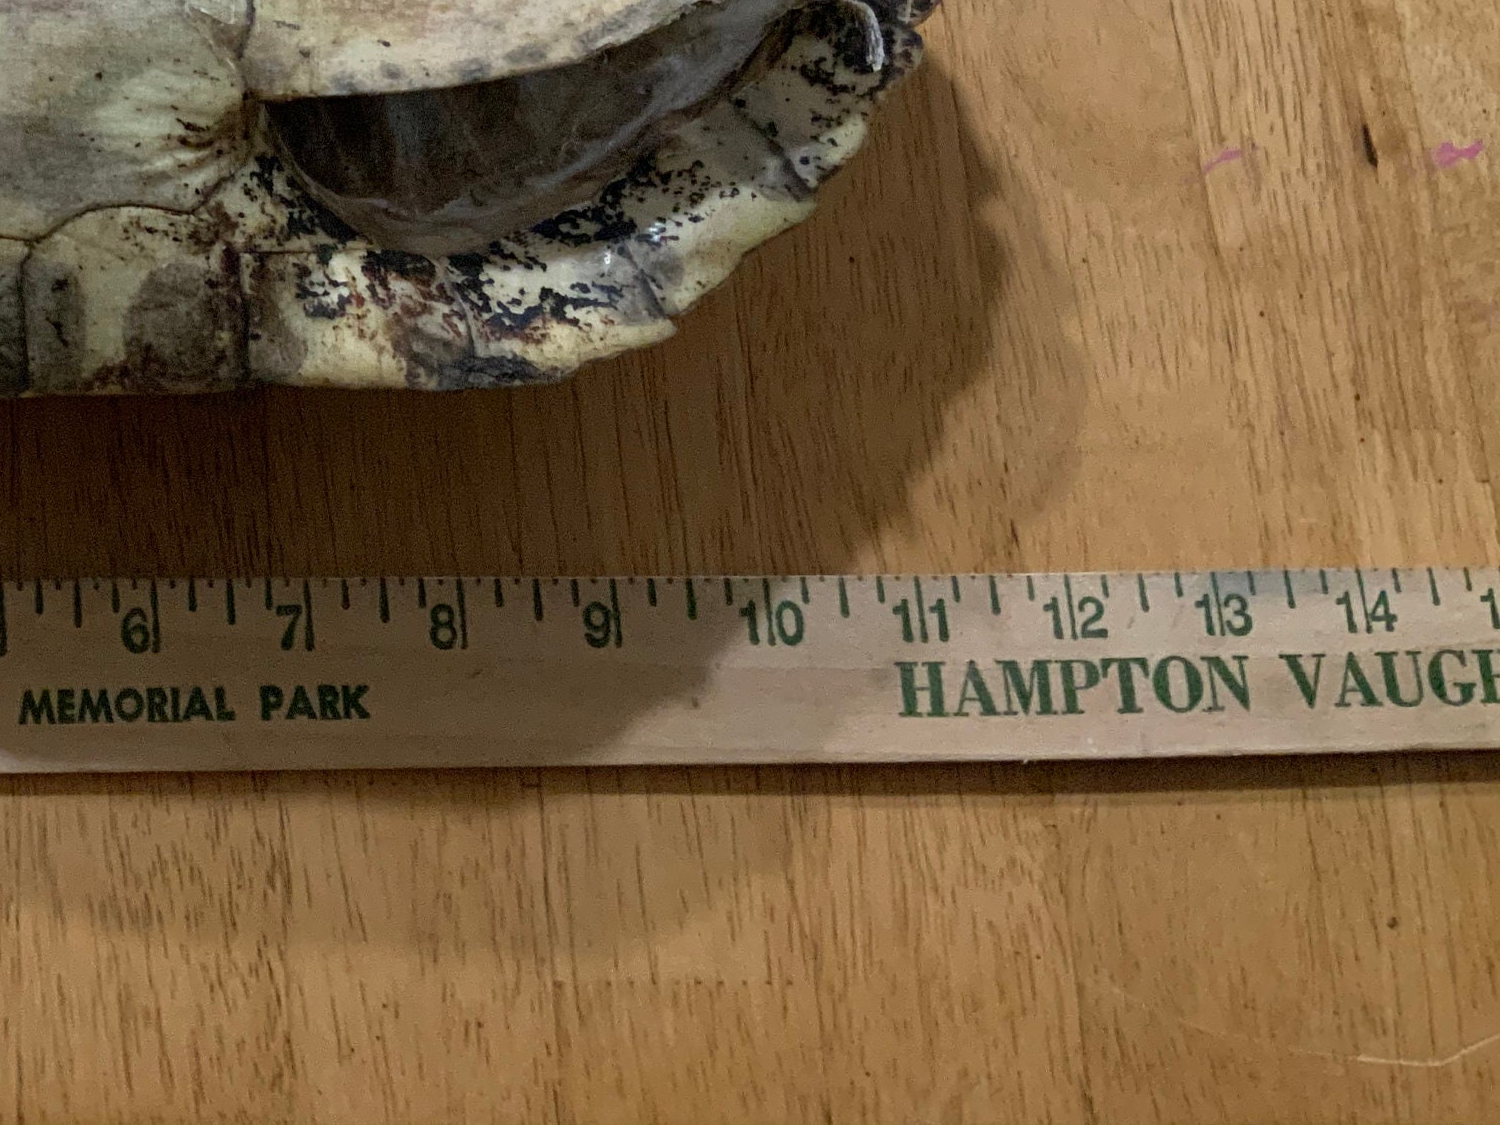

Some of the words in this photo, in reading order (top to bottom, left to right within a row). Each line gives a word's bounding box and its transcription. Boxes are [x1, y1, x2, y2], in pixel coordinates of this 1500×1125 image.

[121, 607, 150, 655] 6
[275, 604, 302, 652] 7
[429, 603, 458, 650] 8
[582, 601, 611, 648] 9
[739, 599, 804, 646] 10
[1043, 596, 1109, 640] 12
[1195, 592, 1254, 636] 13
[1336, 590, 1397, 634] 14
[18, 685, 236, 725] MEMORIAL
[259, 683, 371, 722] PARK
[894, 654, 1252, 718] HAMPTON
